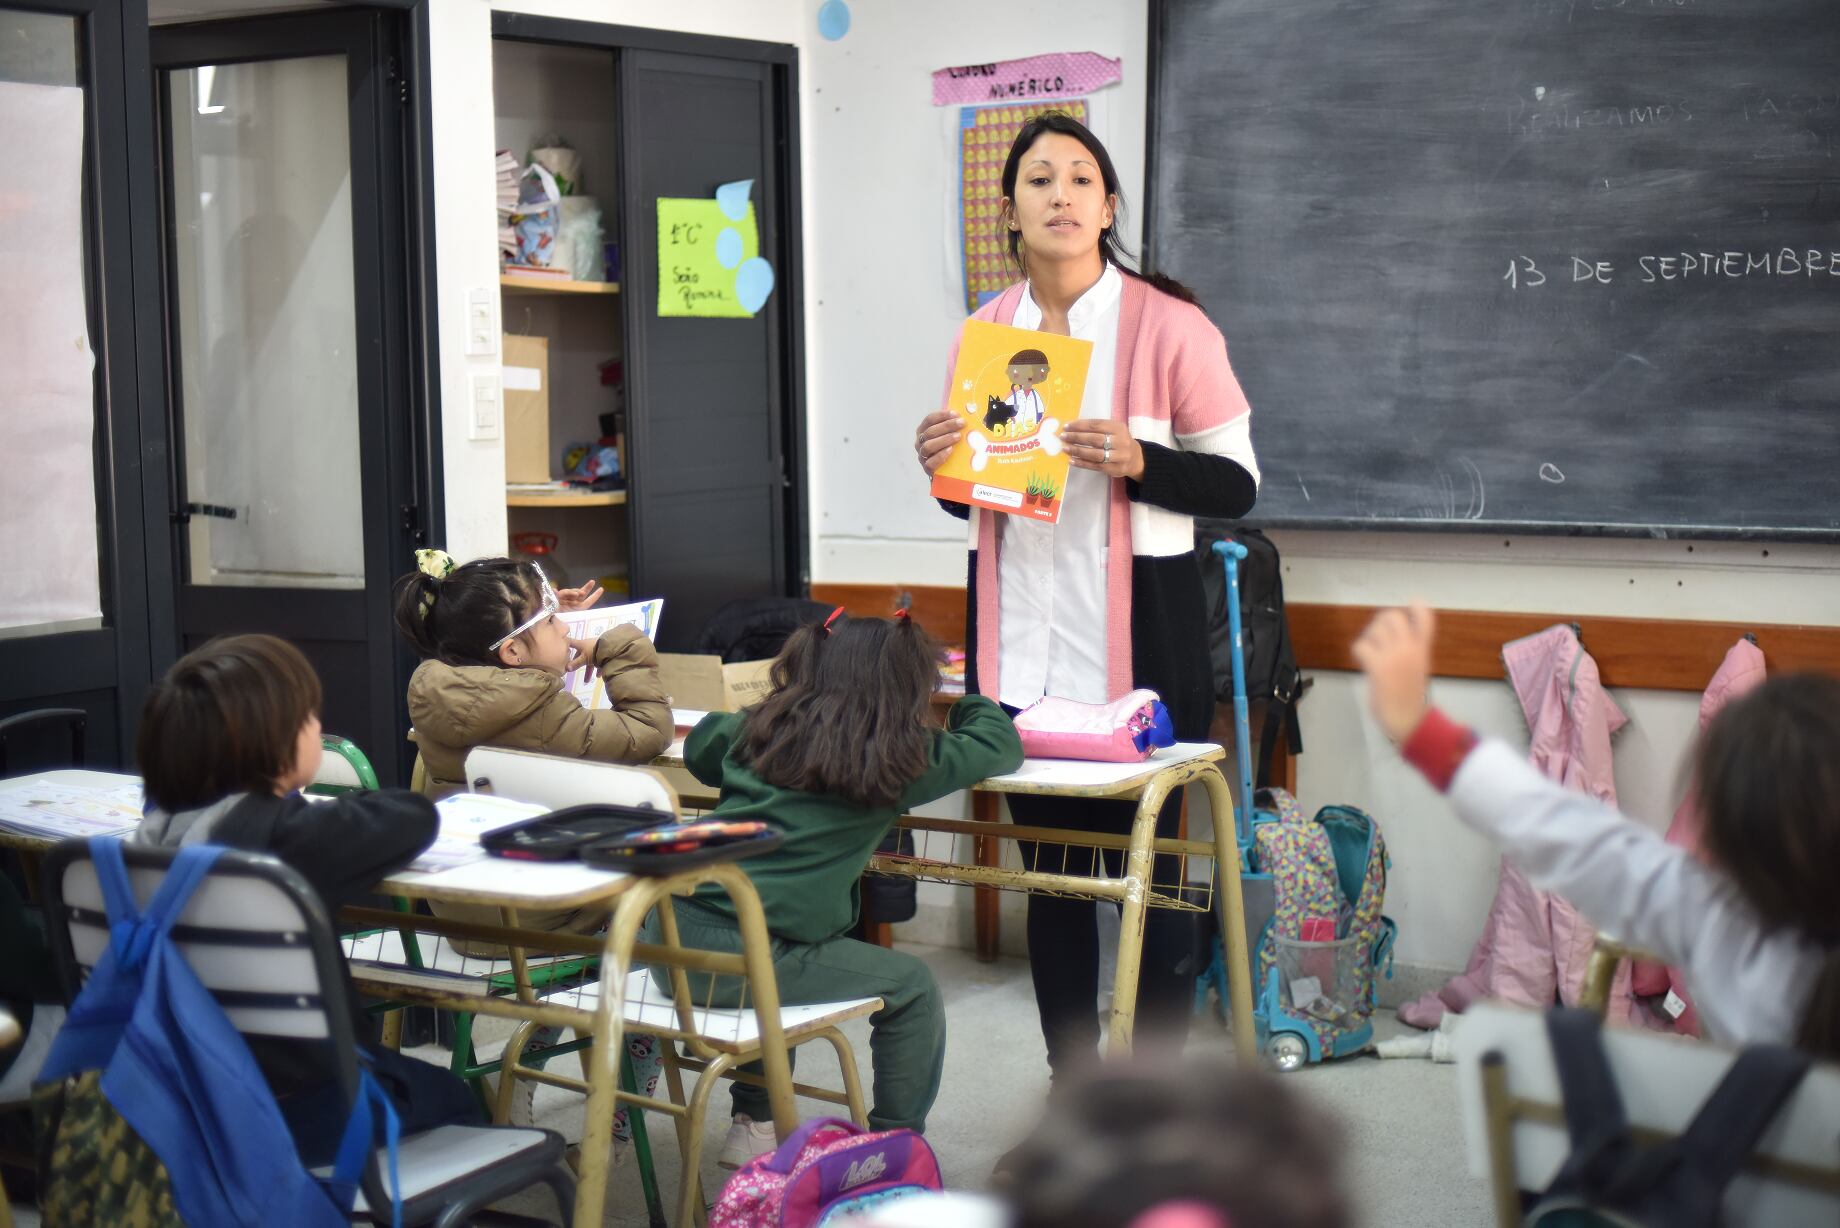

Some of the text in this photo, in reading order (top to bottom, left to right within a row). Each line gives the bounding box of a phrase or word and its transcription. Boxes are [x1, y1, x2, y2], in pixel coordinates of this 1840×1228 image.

[1503, 247, 1840, 289] 13 DE SEPTIEMBRE
[993, 417, 1037, 438] DÍAS
[985, 438, 1041, 454] ANIMADOS
